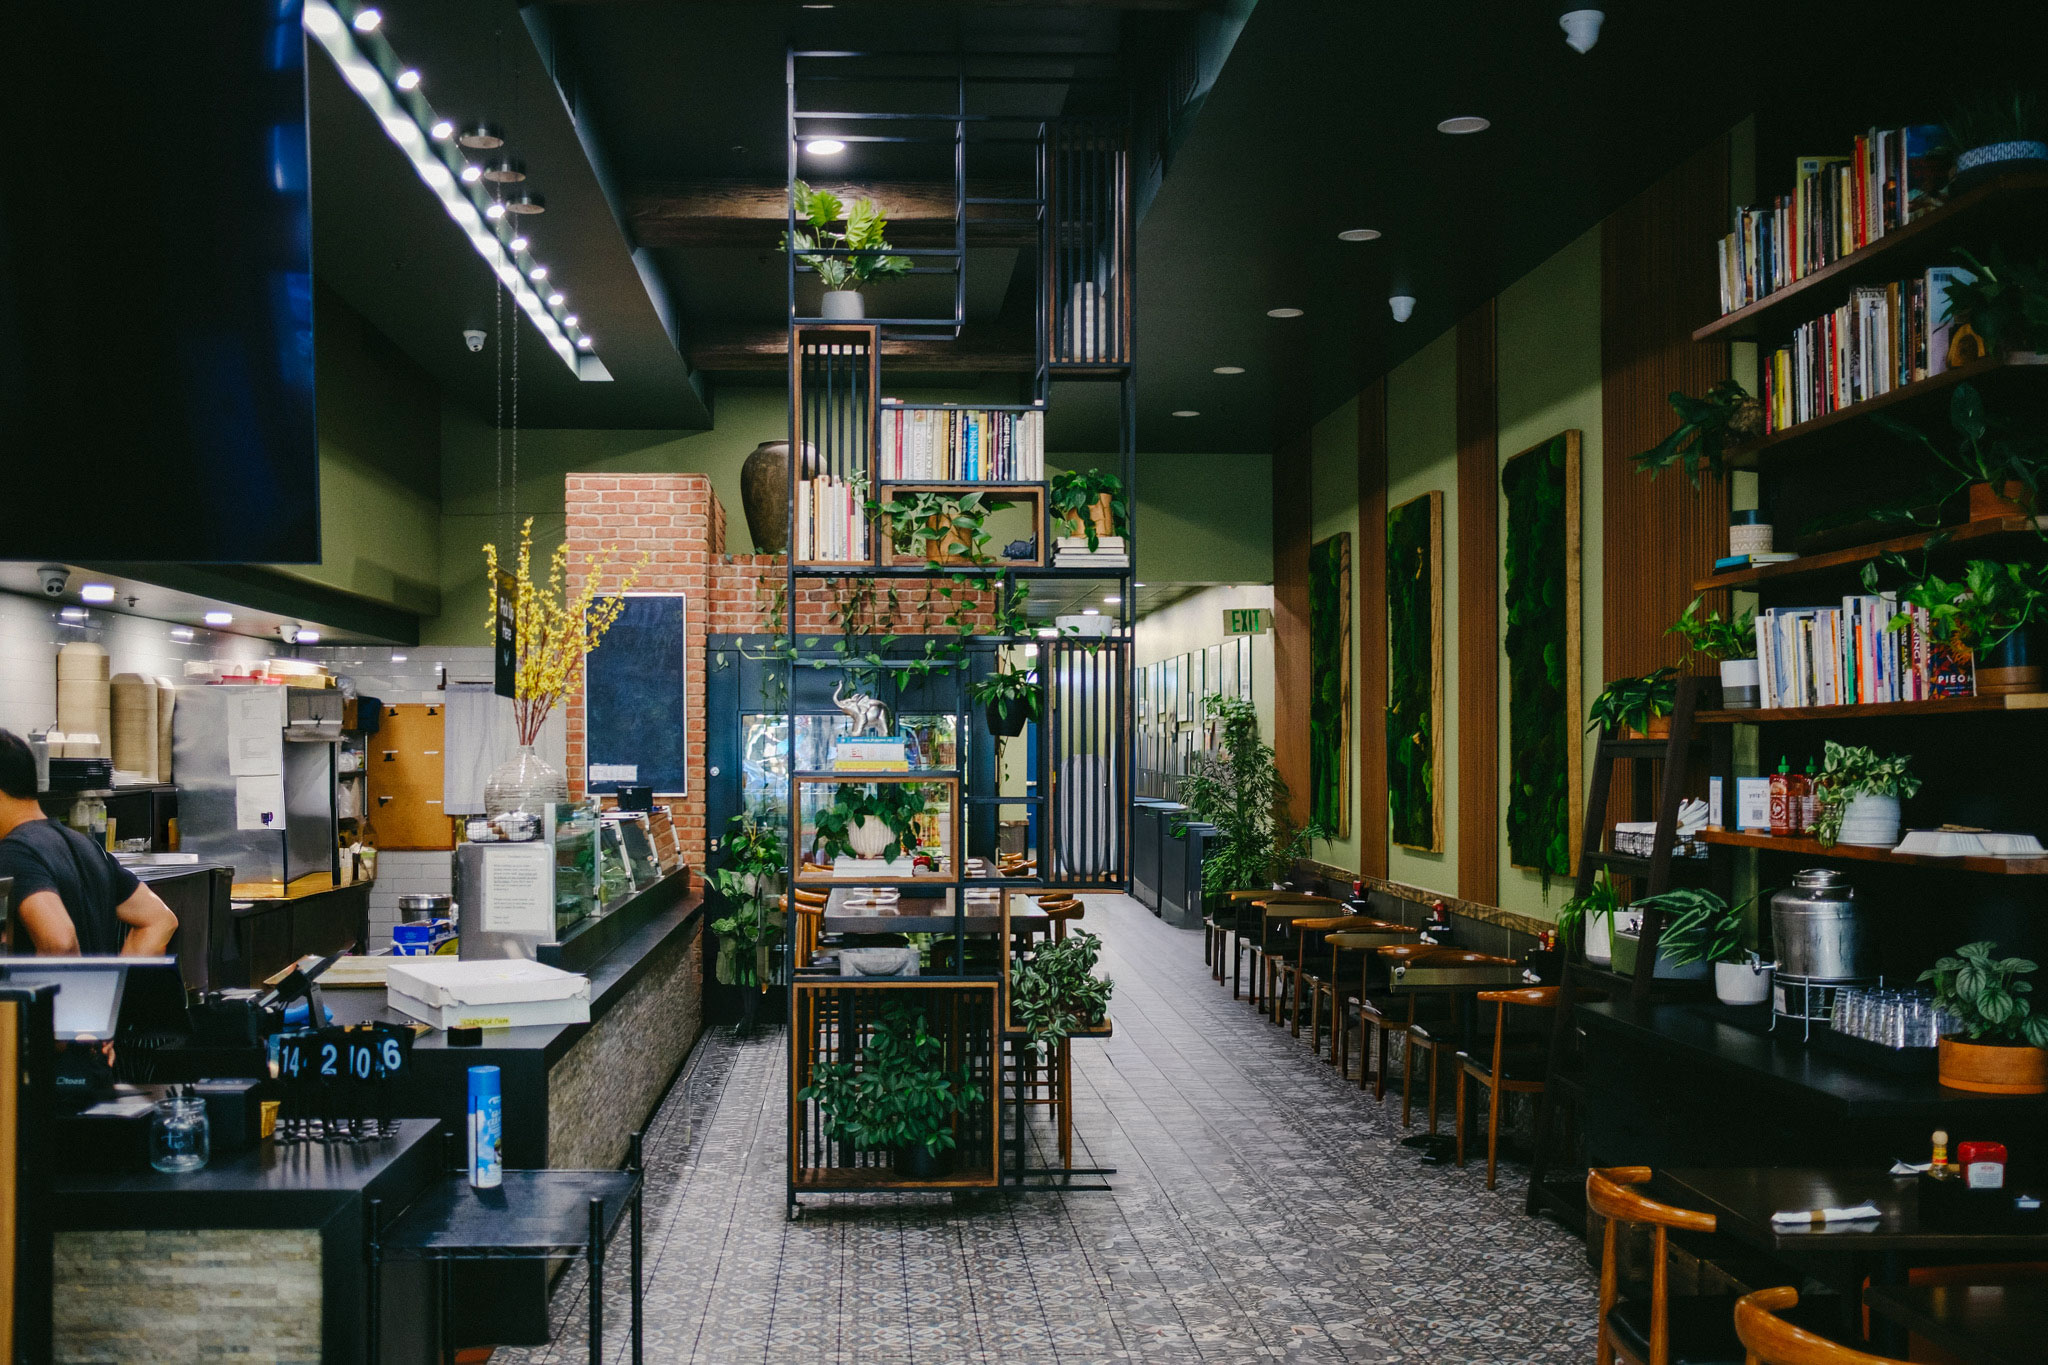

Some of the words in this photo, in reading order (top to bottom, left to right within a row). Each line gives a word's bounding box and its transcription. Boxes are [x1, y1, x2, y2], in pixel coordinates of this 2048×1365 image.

[968, 424, 978, 464] DRINKS
[1231, 609, 1260, 632] EXIT
[1913, 611, 1921, 659] BAKING
[350, 1044, 371, 1079] 10
[382, 1039, 402, 1070] 6
